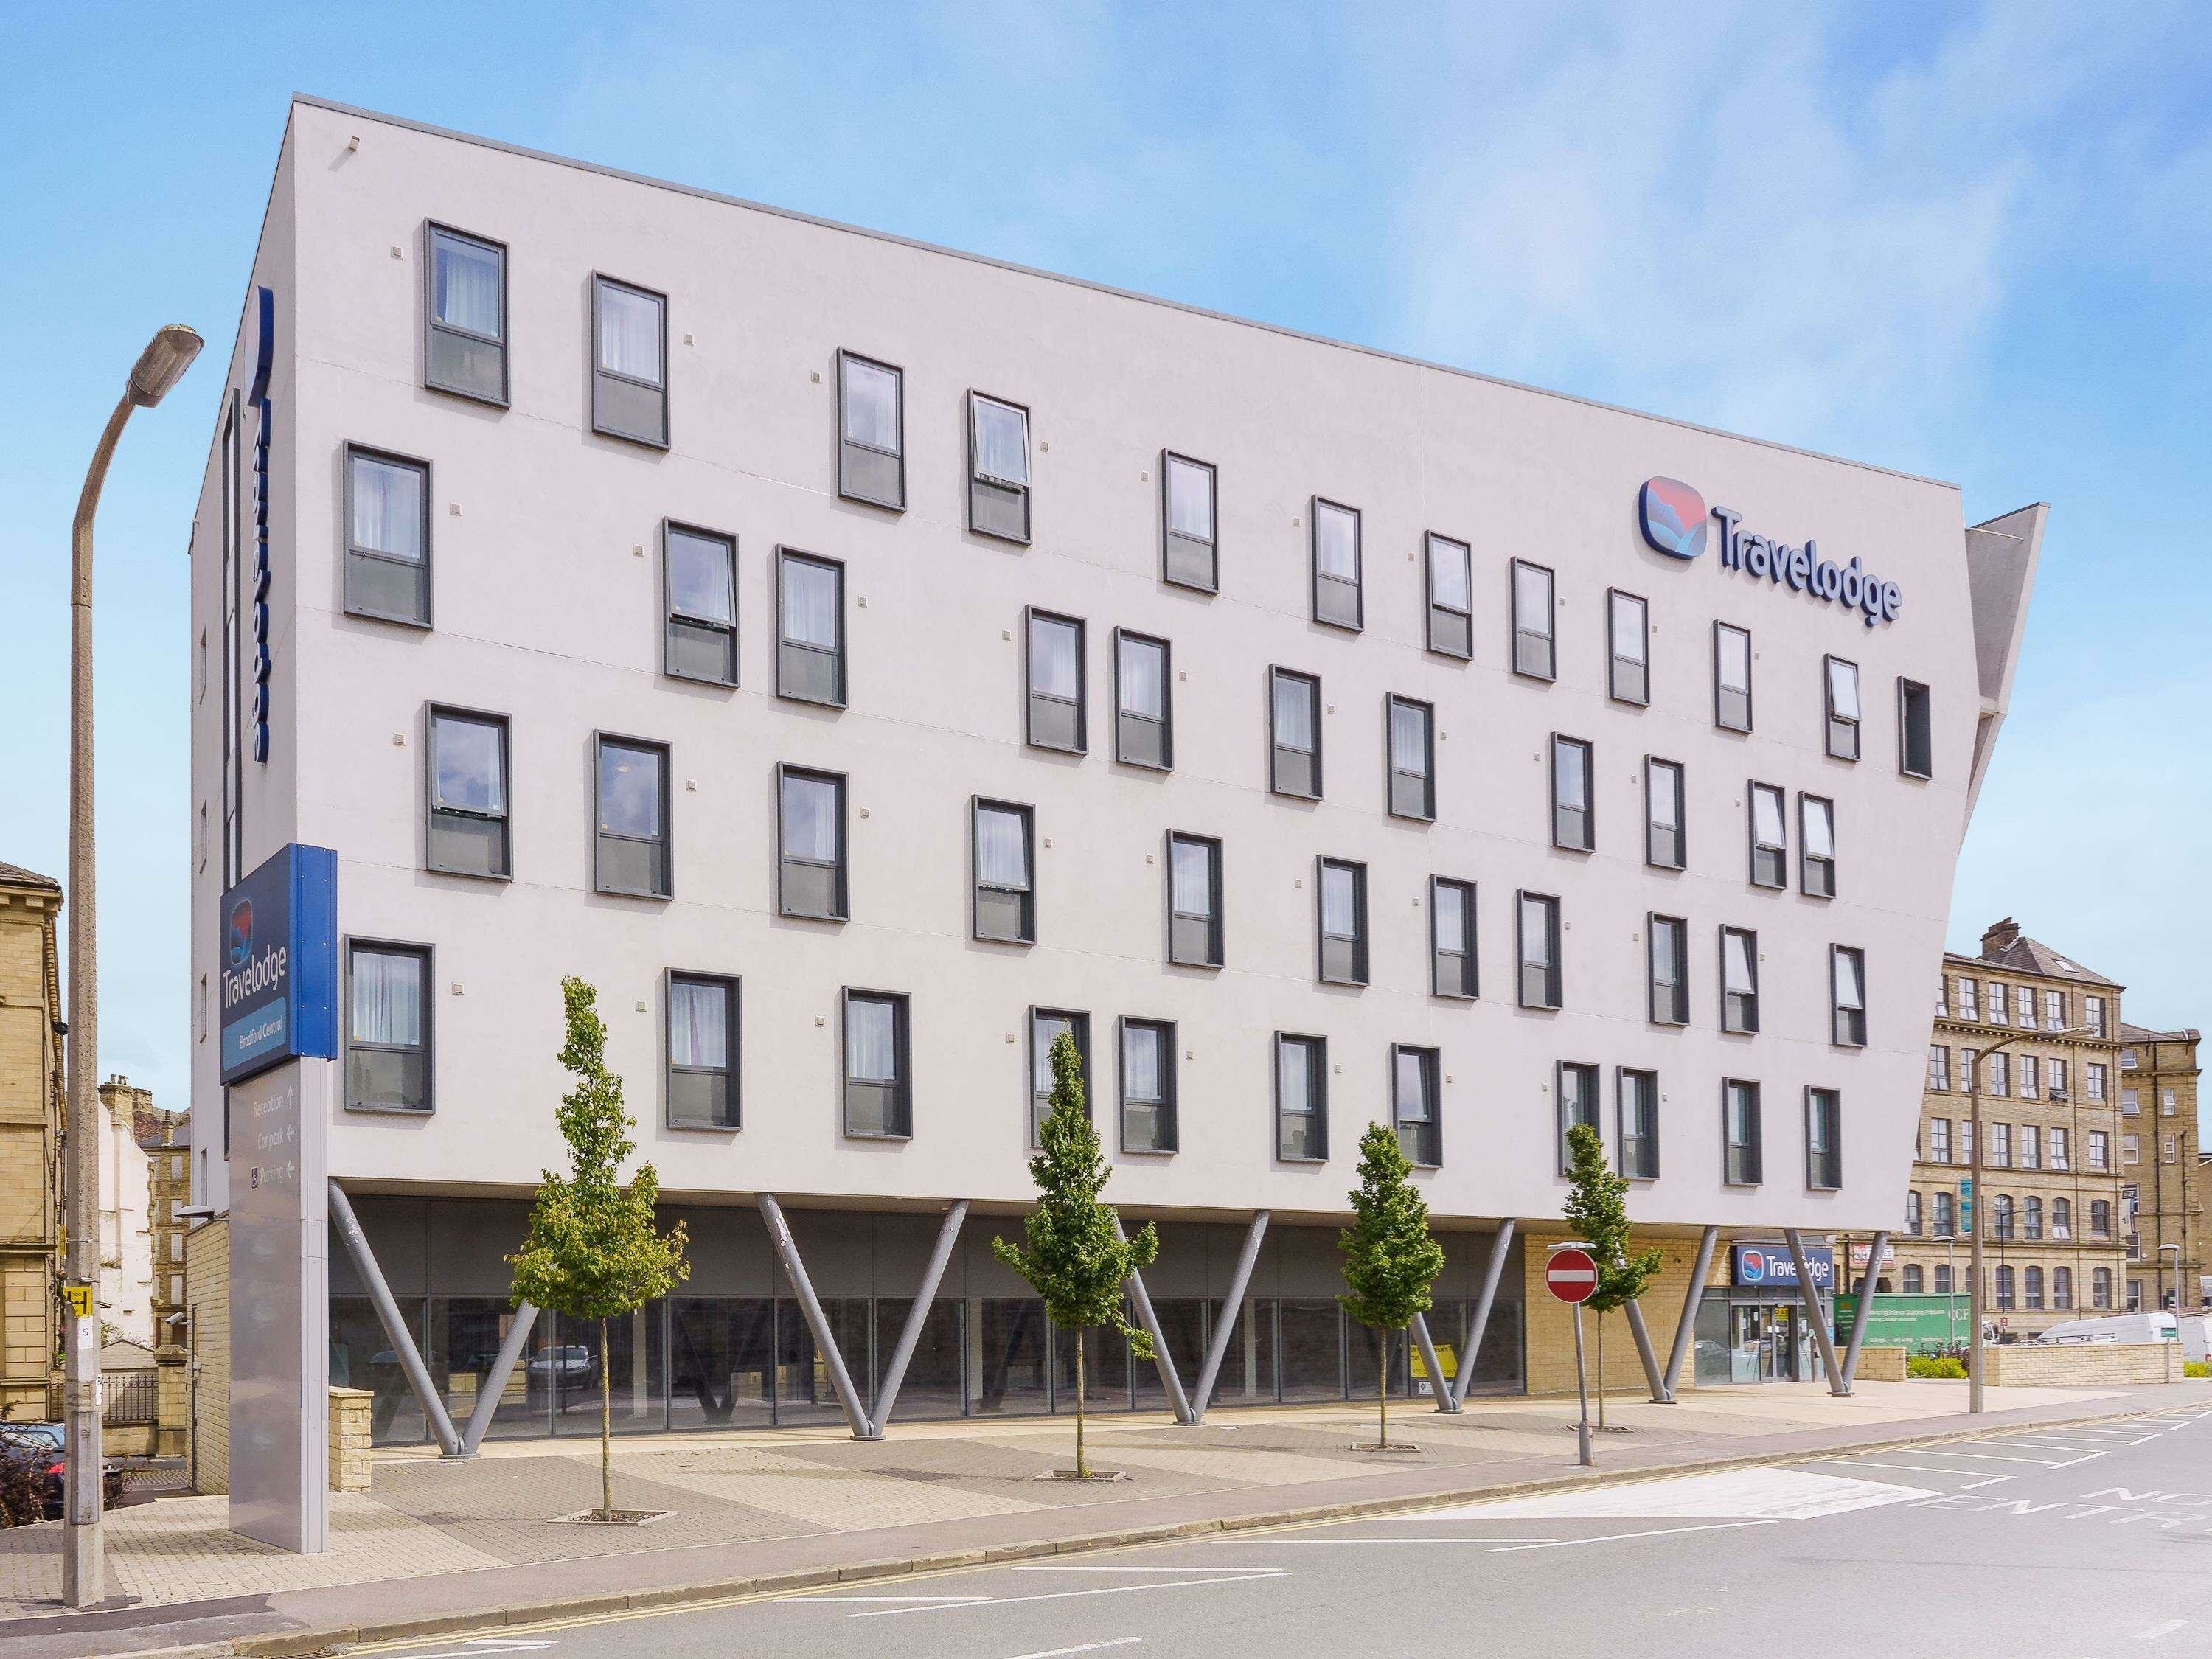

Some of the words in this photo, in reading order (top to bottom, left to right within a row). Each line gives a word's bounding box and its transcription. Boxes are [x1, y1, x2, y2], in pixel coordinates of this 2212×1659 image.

[1711, 505, 1904, 628] Travelodge
[223, 944, 287, 1009] Travelodge
[239, 1026, 262, 1050] Bradford
[262, 1015, 284, 1038] Central
[253, 1094, 284, 1118] Reception
[258, 1133, 268, 1150] Car
[268, 1127, 284, 1151] park
[260, 1164, 284, 1185] Parking
[1766, 1255, 1829, 1282] Travedge
[83, 1328, 88, 1337] 5
[2079, 1487, 2212, 1505] NO
[1907, 1495, 2212, 1531] ENTR
